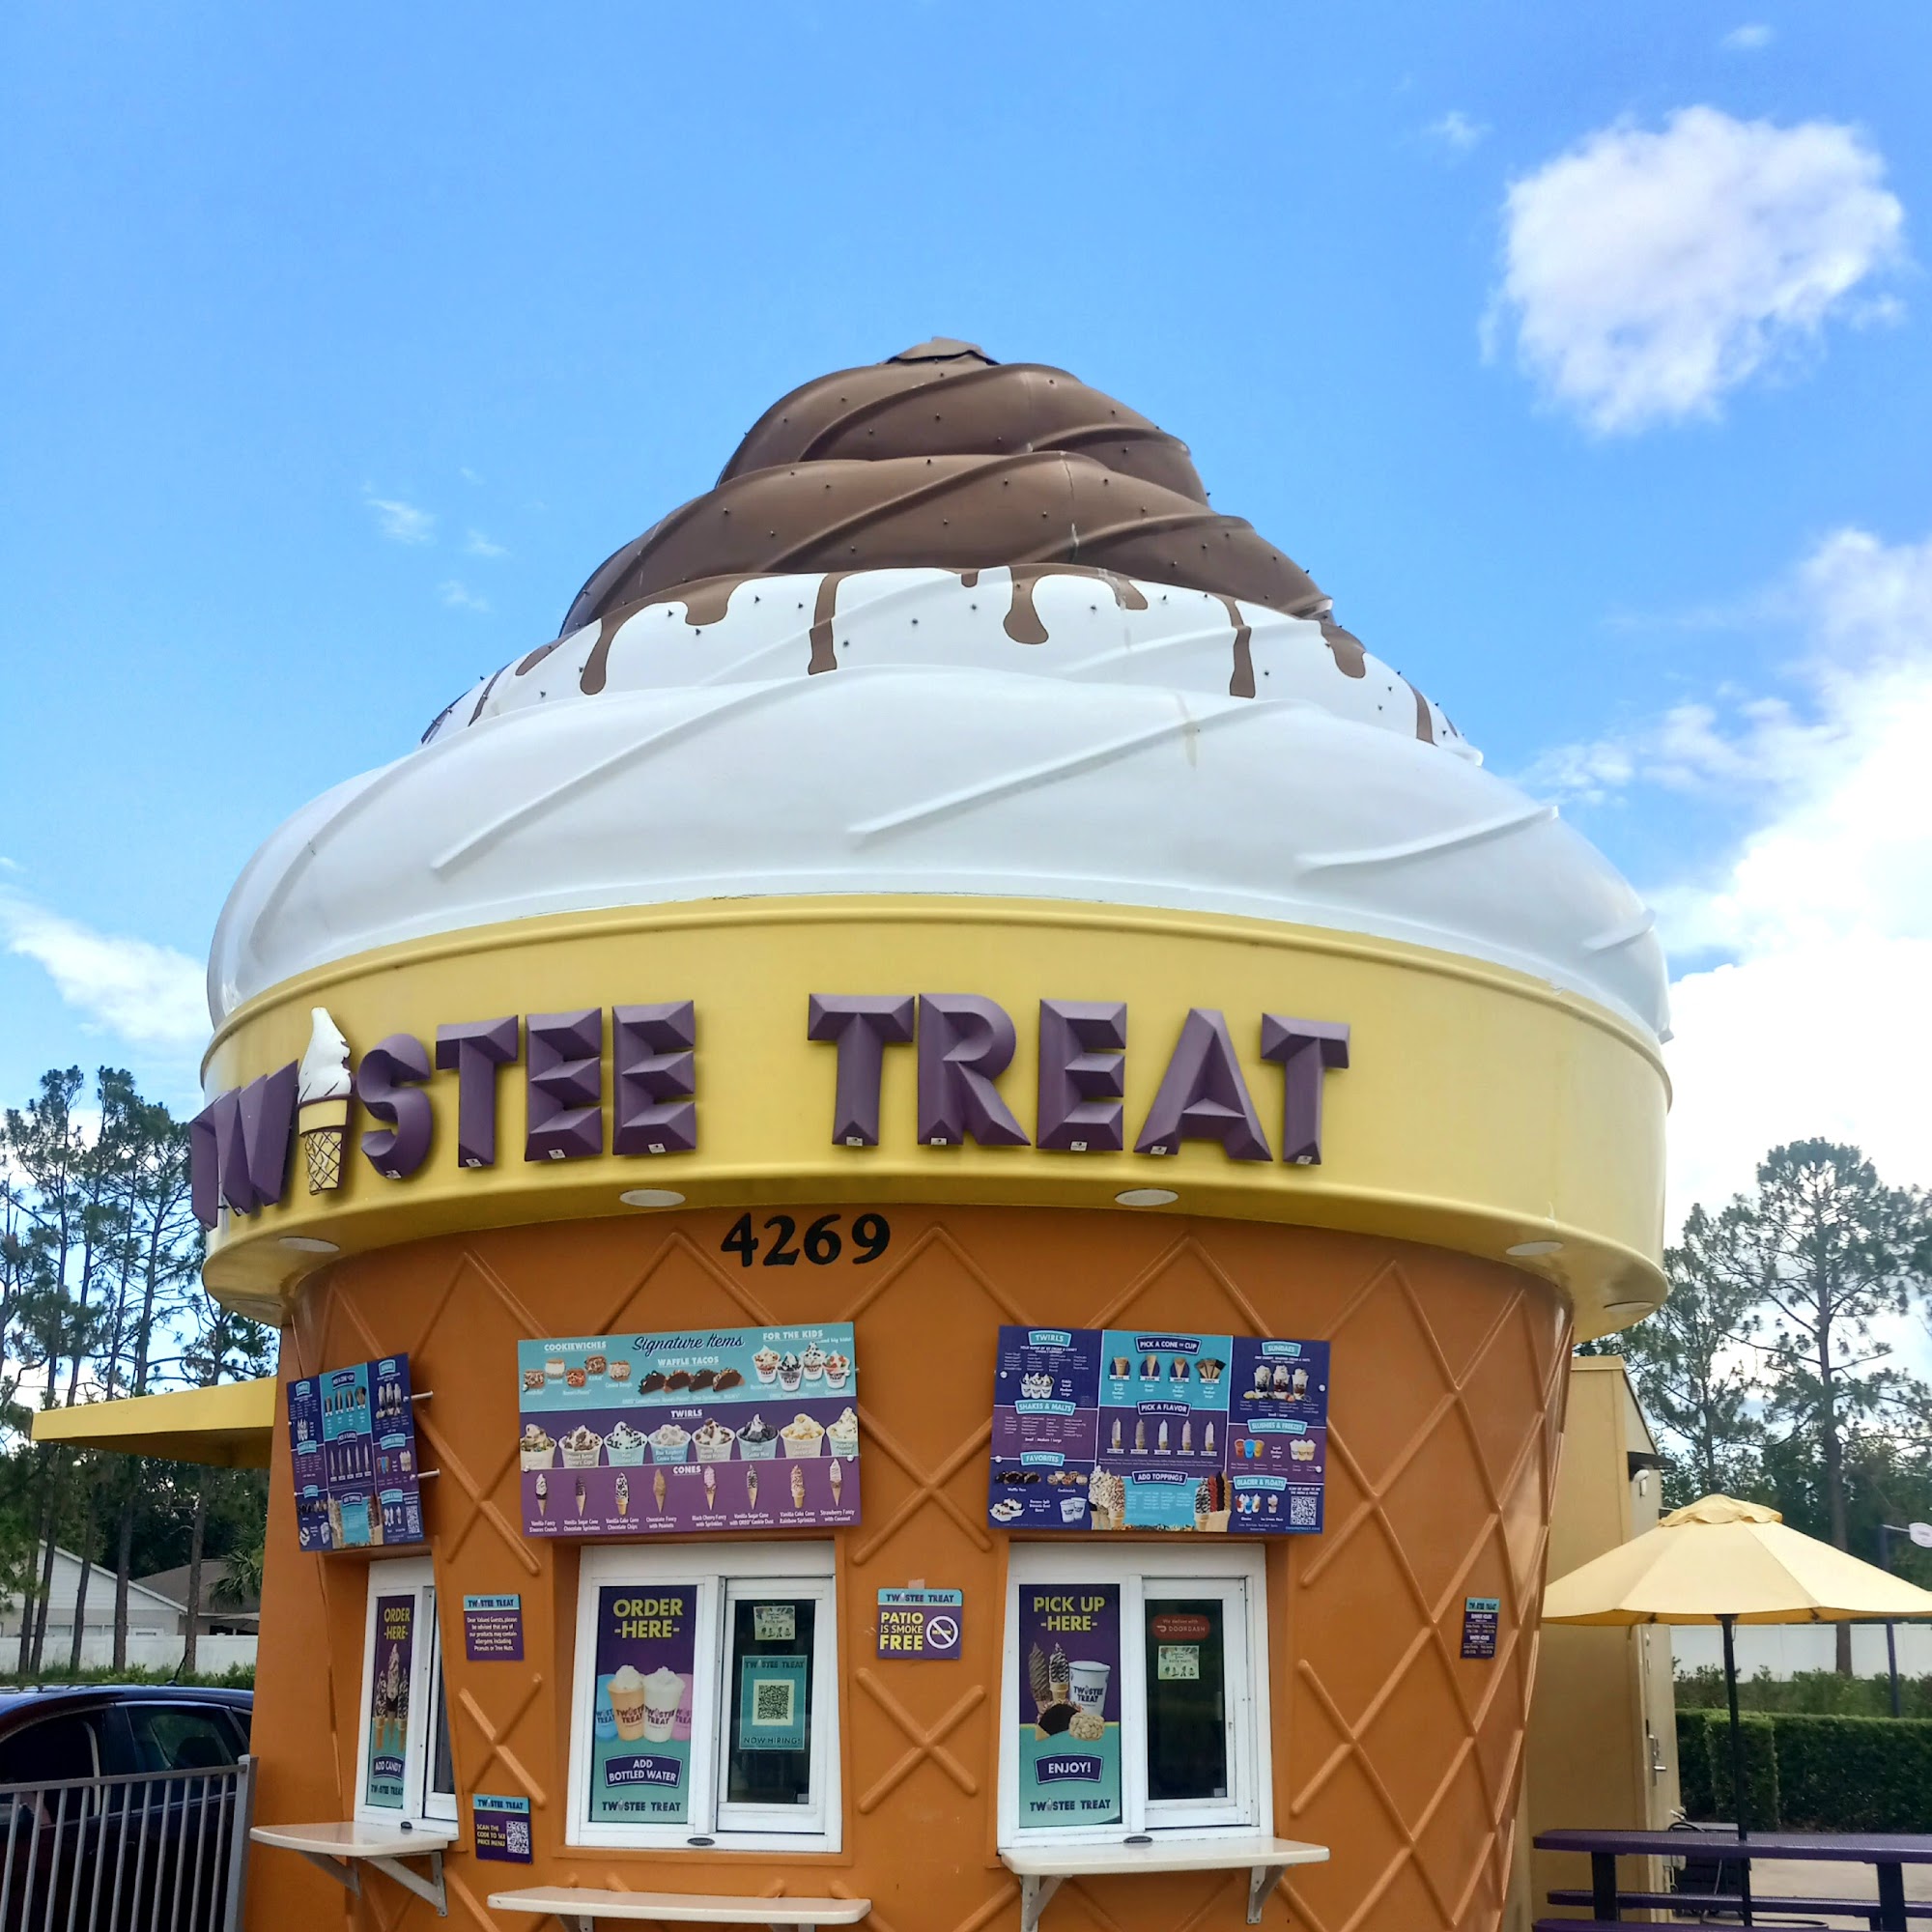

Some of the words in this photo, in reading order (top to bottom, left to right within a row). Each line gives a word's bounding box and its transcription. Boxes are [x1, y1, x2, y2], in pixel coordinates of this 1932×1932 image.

[807, 992, 1350, 1165] TREAT
[721, 1211, 891, 1267] 4269
[544, 1341, 606, 1351] COOKIEWICHES
[632, 1336, 704, 1357] Signature
[706, 1334, 744, 1348] Items
[693, 1356, 719, 1365] TACOS
[671, 1409, 702, 1418] TWIRLS
[673, 1465, 701, 1474] CONES
[928, 1594, 953, 1603] TREAT
[613, 1599, 683, 1617] ORDER
[1034, 1597, 1074, 1612] PICK
[1081, 1597, 1105, 1611] UP
[384, 1607, 410, 1622] ORDER
[881, 1612, 923, 1624] PATIO
[881, 1625, 889, 1634] IS
[892, 1625, 923, 1634] SMOKE
[880, 1634, 923, 1650] FREE
[1078, 1694, 1098, 1703] TREAT
[648, 1715, 668, 1724] TREAT
[376, 1761, 384, 1771] ADD
[385, 1761, 402, 1773] CANDY
[633, 1759, 653, 1768] ADD
[1048, 1762, 1091, 1774] ENJOY!
[609, 1770, 644, 1782] BOTTLED
[646, 1770, 676, 1782] WATER
[651, 1802, 681, 1811] TREAT
[1080, 1799, 1111, 1810] TREAT
